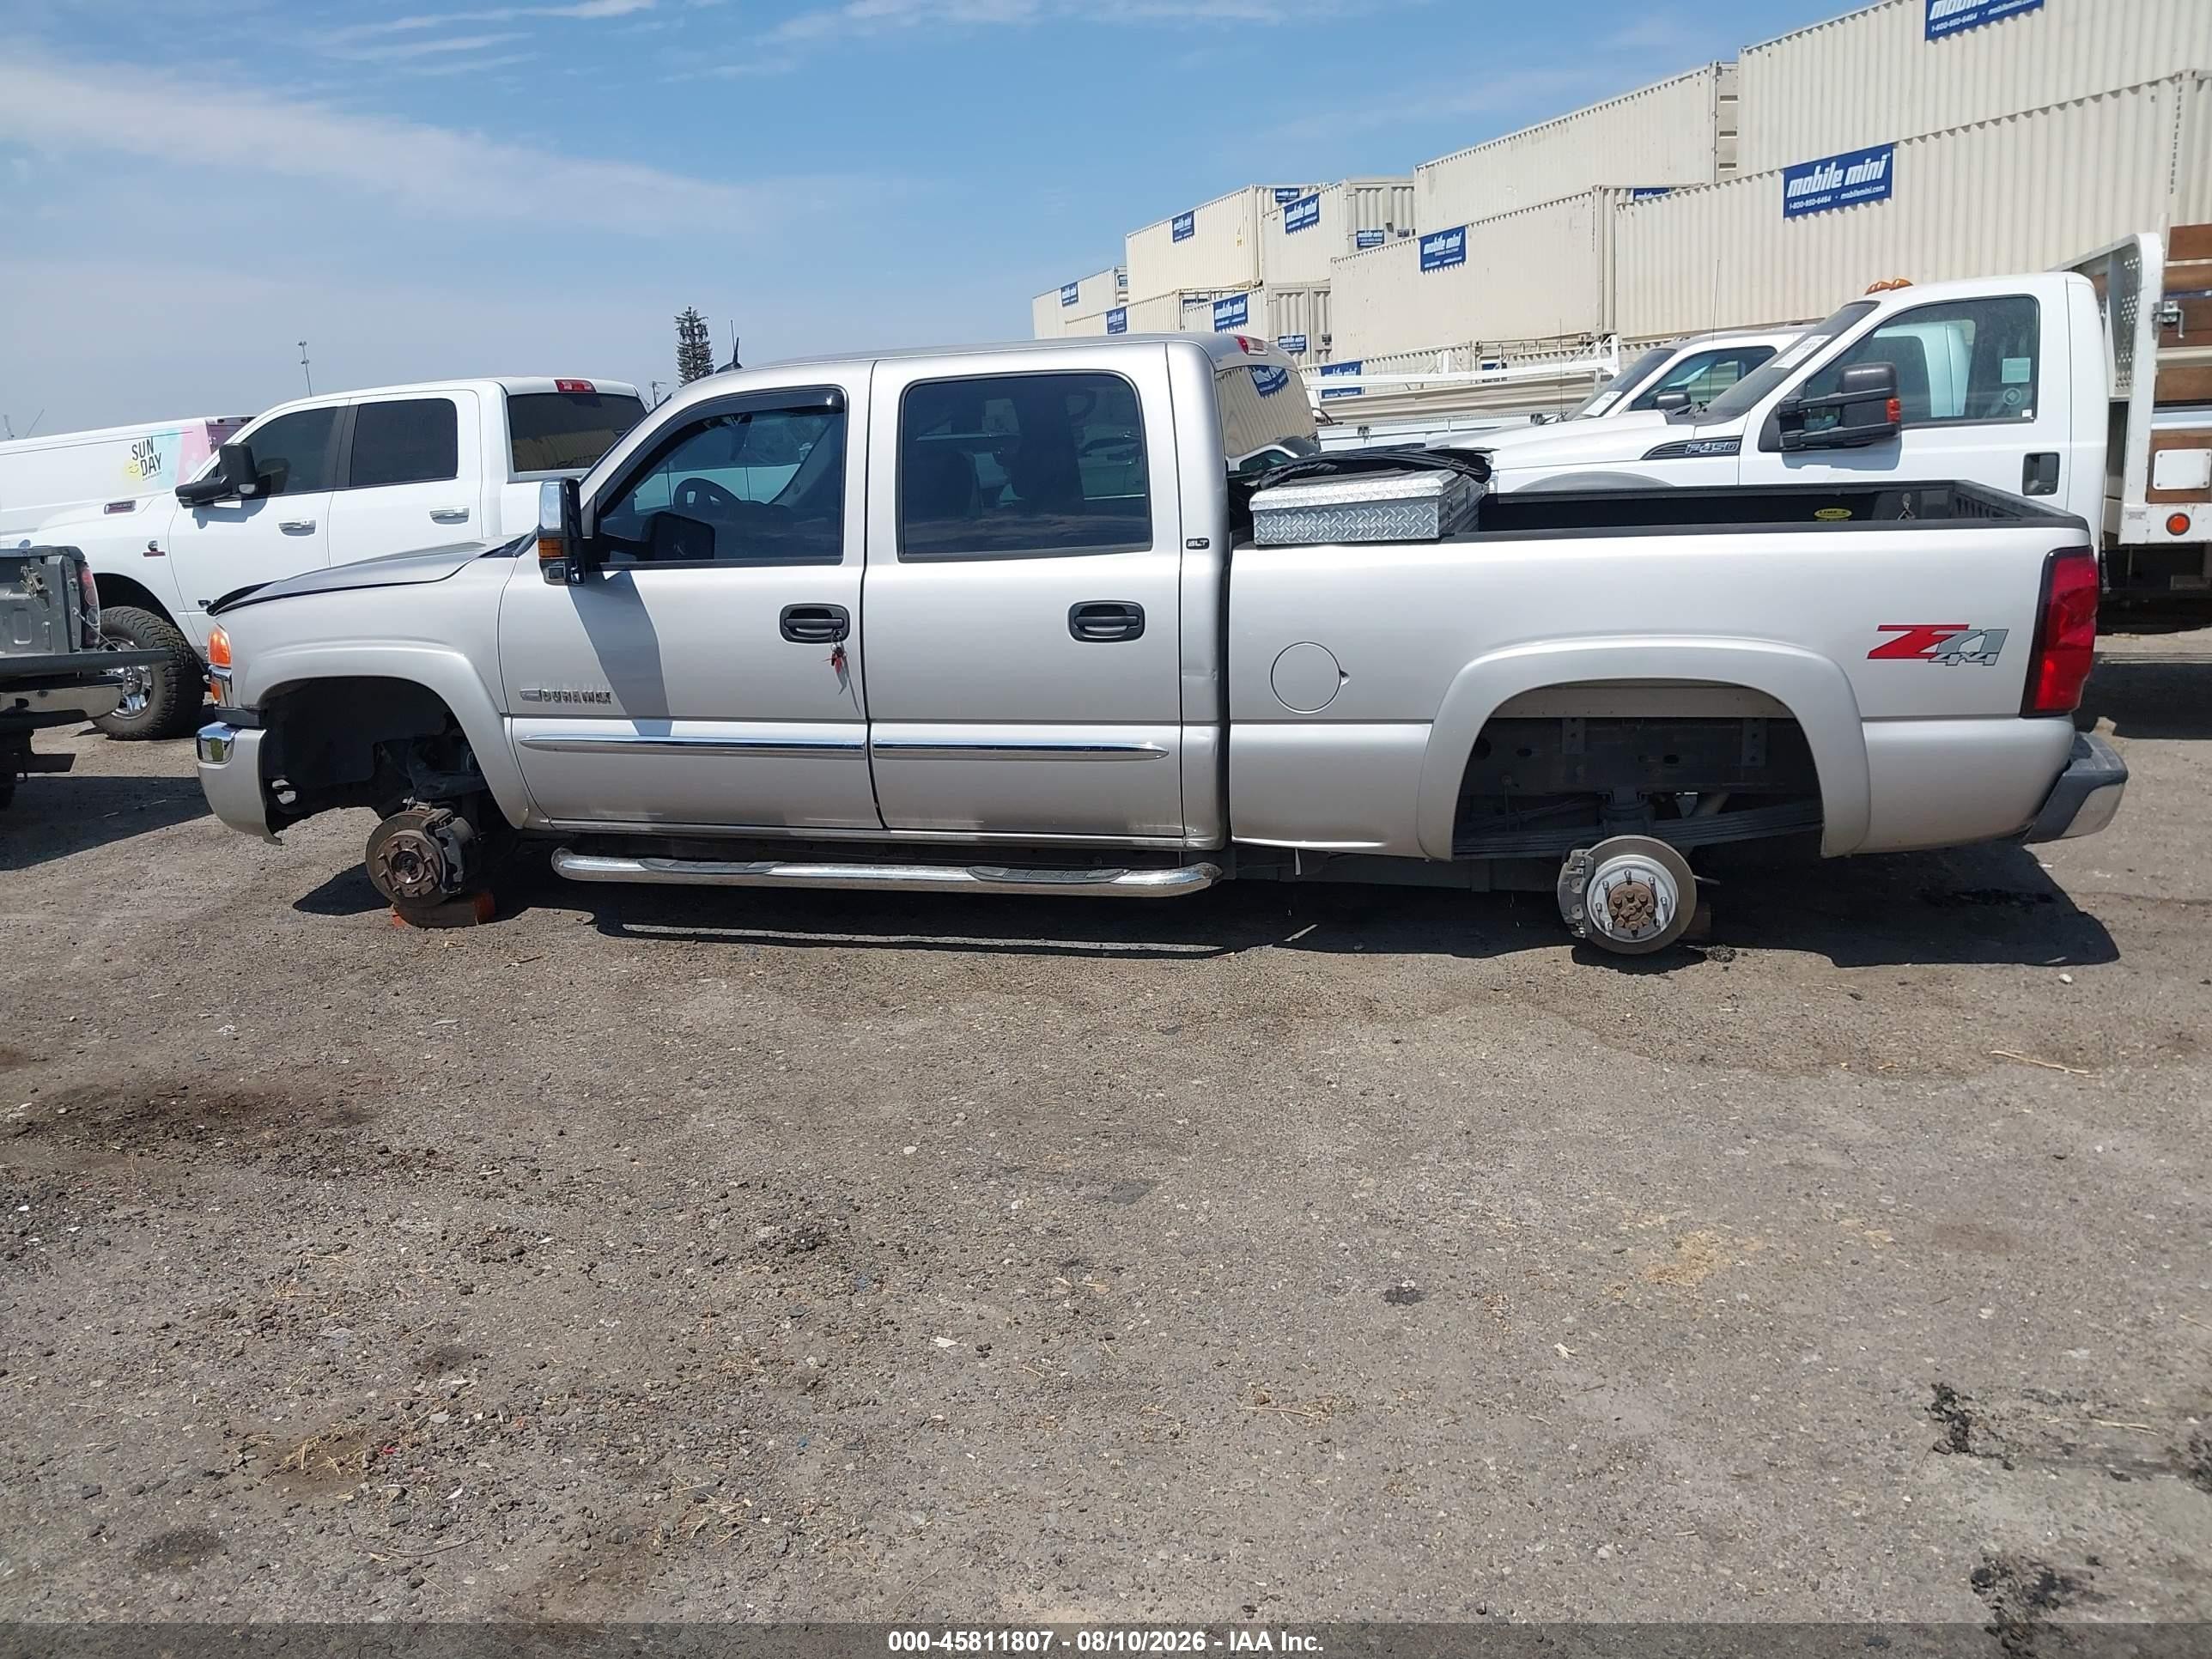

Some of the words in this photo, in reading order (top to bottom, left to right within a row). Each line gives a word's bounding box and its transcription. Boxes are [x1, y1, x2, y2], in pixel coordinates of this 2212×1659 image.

[1787, 161, 1844, 198] mobile
[1844, 154, 1888, 185] mini
[1840, 185, 1886, 199] mobilemini.com
[1286, 203, 1304, 223] mobile
[1424, 235, 1445, 255] mobile
[1446, 232, 1462, 249] mini
[1215, 301, 1233, 320] mobile
[1233, 299, 1246, 315] mini
[131, 436, 155, 461] SUN
[140, 452, 162, 477] DAY
[1867, 624, 2009, 660] Z71
[542, 689, 612, 704] DURAMAX
